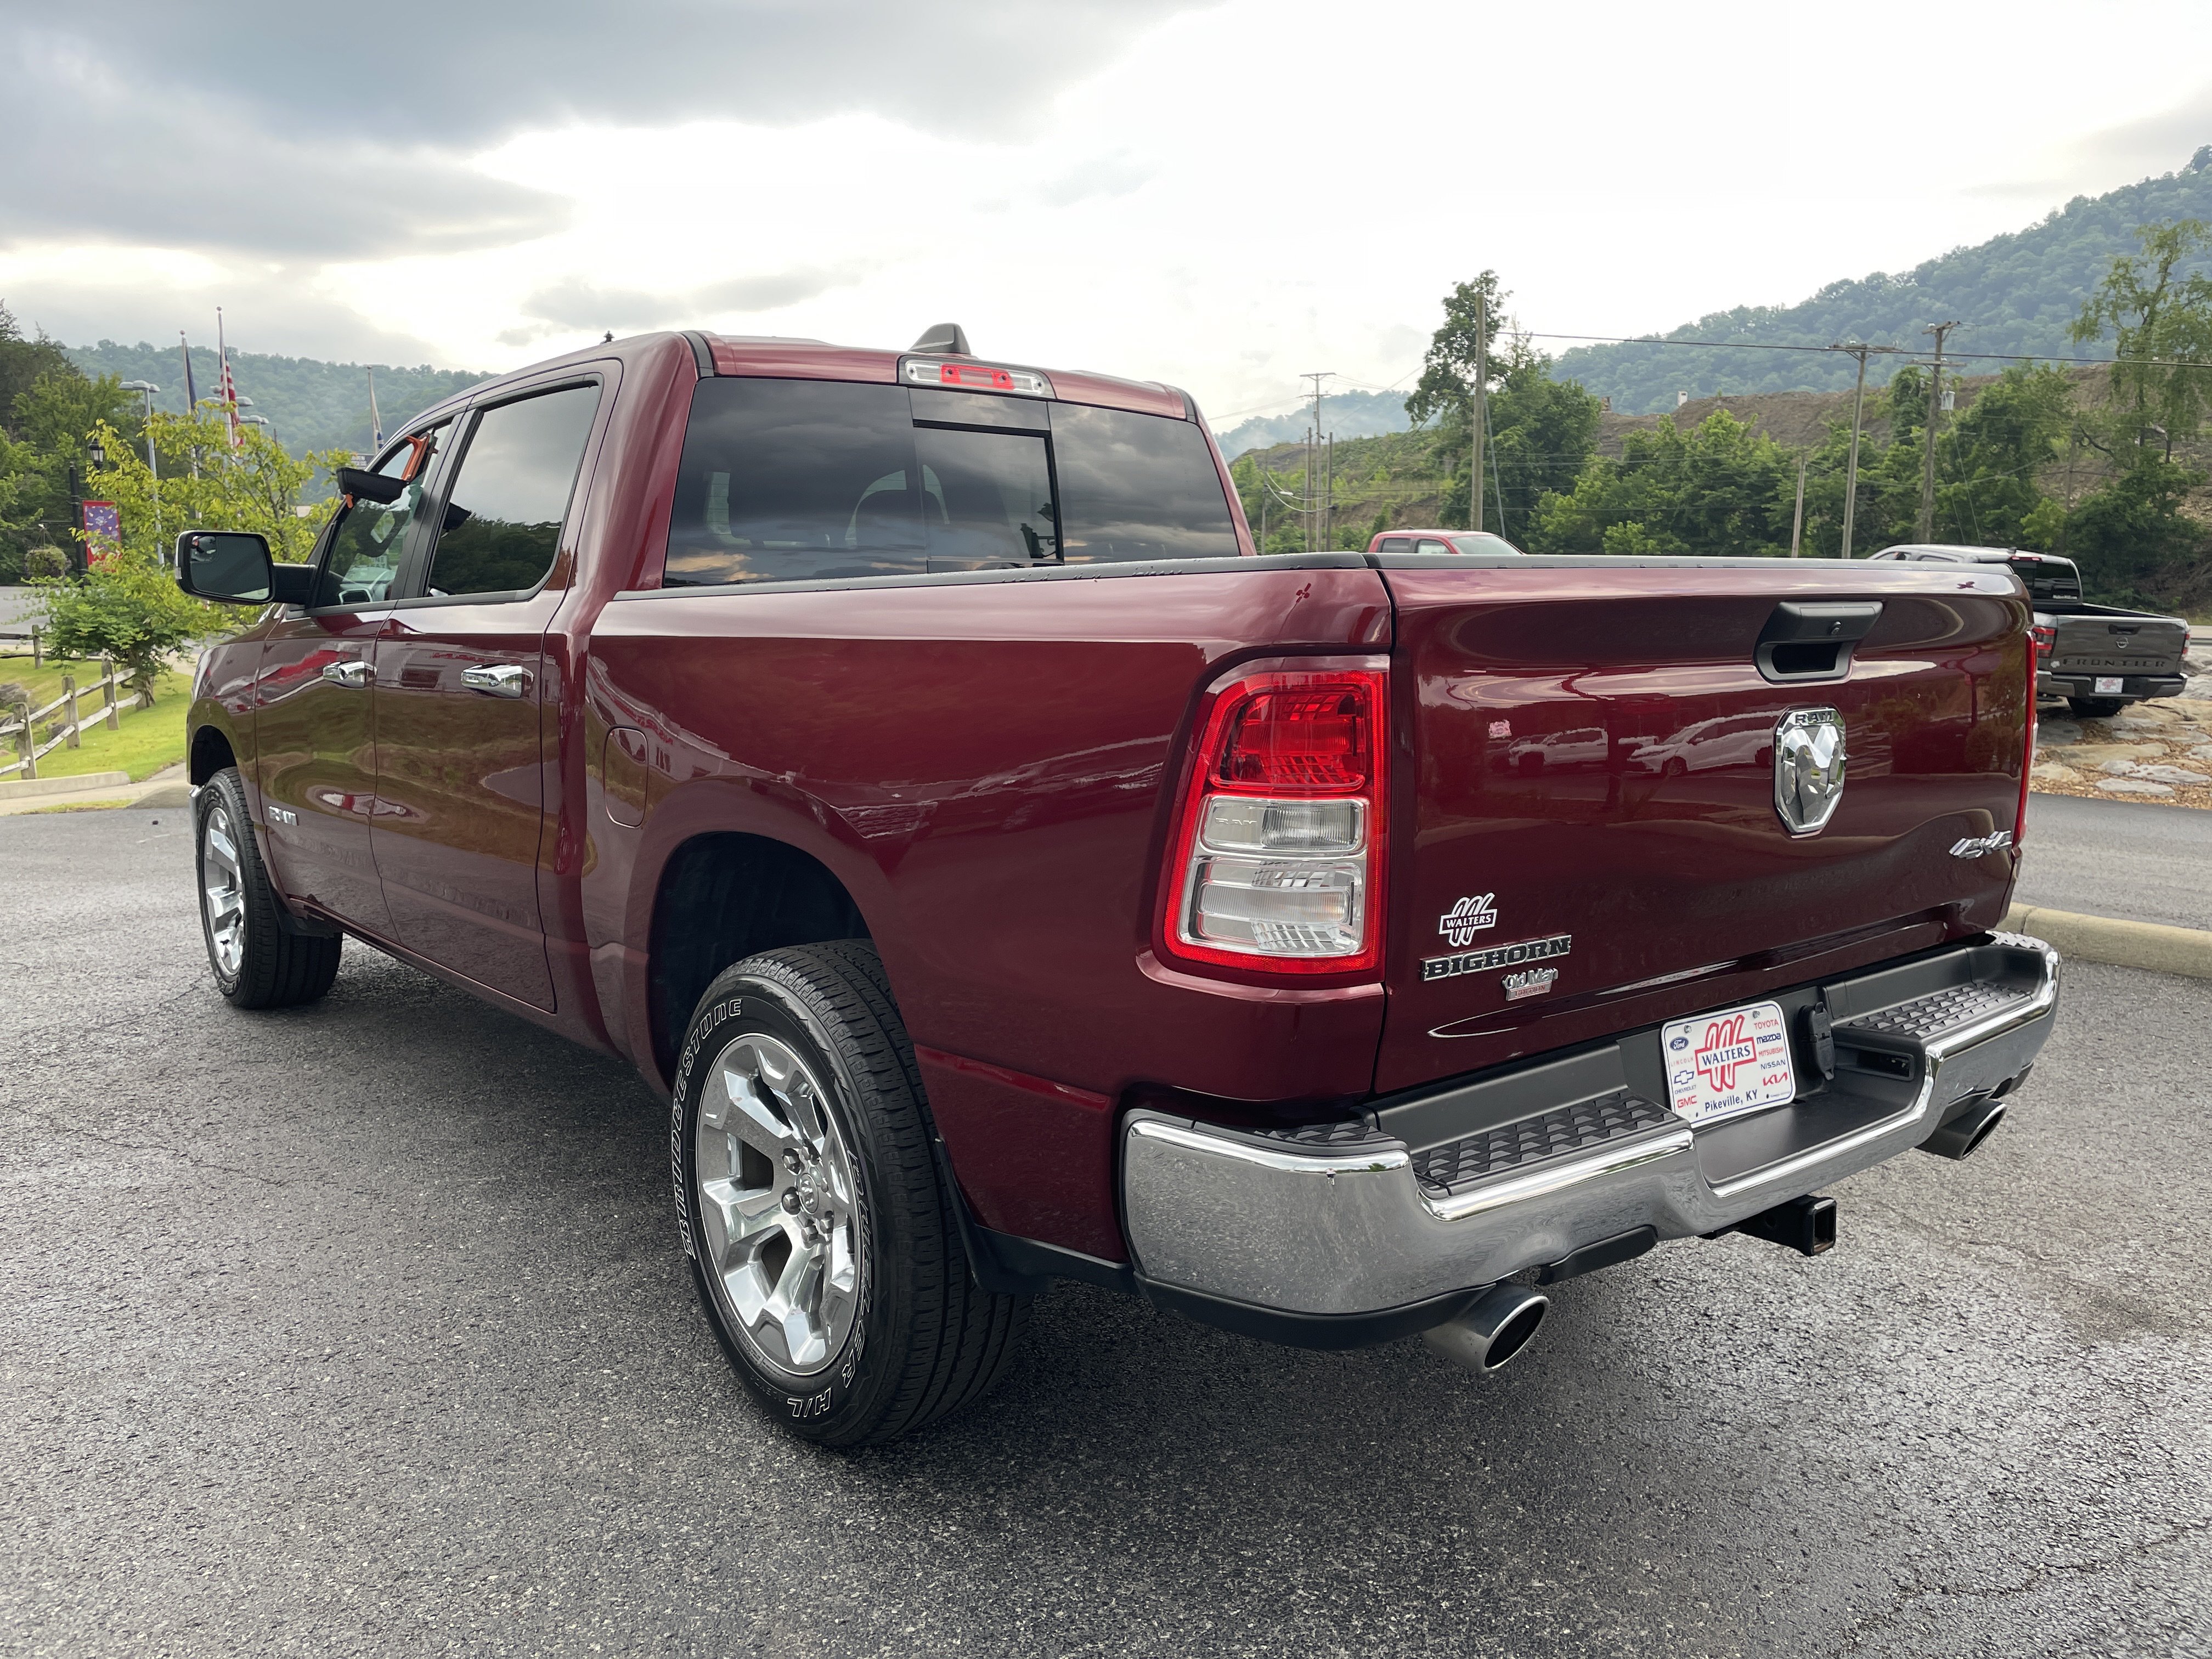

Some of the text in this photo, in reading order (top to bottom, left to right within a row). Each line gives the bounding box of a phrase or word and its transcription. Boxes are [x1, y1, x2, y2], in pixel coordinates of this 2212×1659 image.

[2063, 658, 2165, 667] FRONTIER
[1795, 713, 1833, 725] RAM
[1446, 913, 1492, 928] WALTERS
[1754, 1019, 1779, 1030] TOYOTA
[1702, 1045, 1751, 1066] WALTERS
[1758, 1046, 1784, 1057] MITSUBISHI
[1671, 1056, 1694, 1067] LINCOLN
[1763, 1072, 1788, 1086] KIA
[1675, 1085, 1697, 1095] CHEVROLET
[1677, 1095, 1697, 1108] GMC
[1705, 1094, 1743, 1112] Pikeville,
[1746, 1089, 1758, 1101] KY
